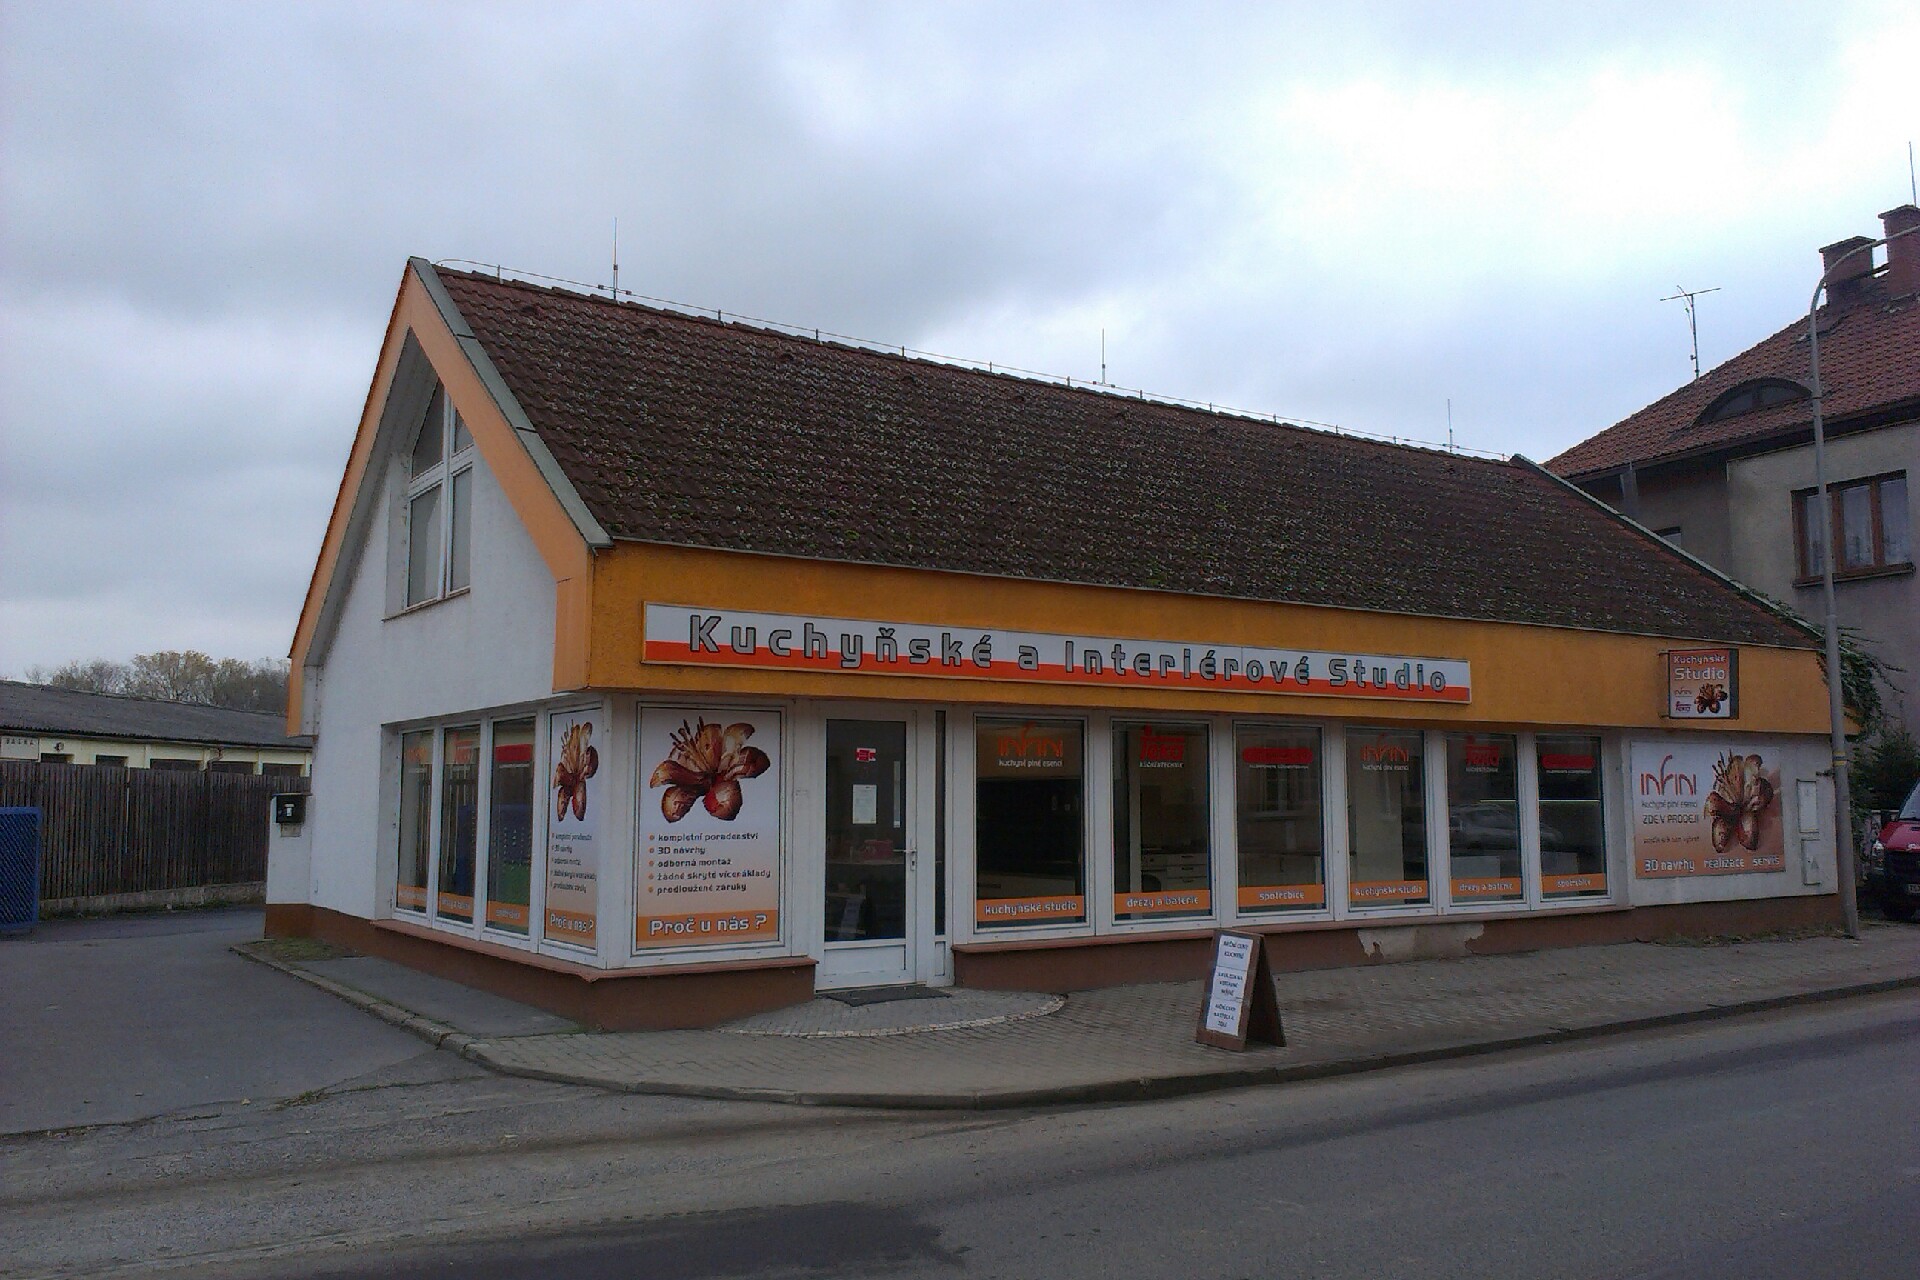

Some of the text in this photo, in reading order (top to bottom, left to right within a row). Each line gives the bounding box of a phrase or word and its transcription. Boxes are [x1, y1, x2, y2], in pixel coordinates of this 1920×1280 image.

[689, 614, 1447, 692] Kuchyňské a Interiérové Studio
[1674, 667, 1726, 681] Studio
[658, 833, 703, 843] kompletní
[658, 845, 706, 855] 3D návrhy
[658, 859, 697, 867] odborná
[1703, 857, 1745, 869] realizace
[1044, 901, 1077, 912] studio
[1156, 897, 1164, 906] a
[650, 917, 696, 936] Proč
[701, 920, 711, 932] u
[717, 915, 750, 931] nás
